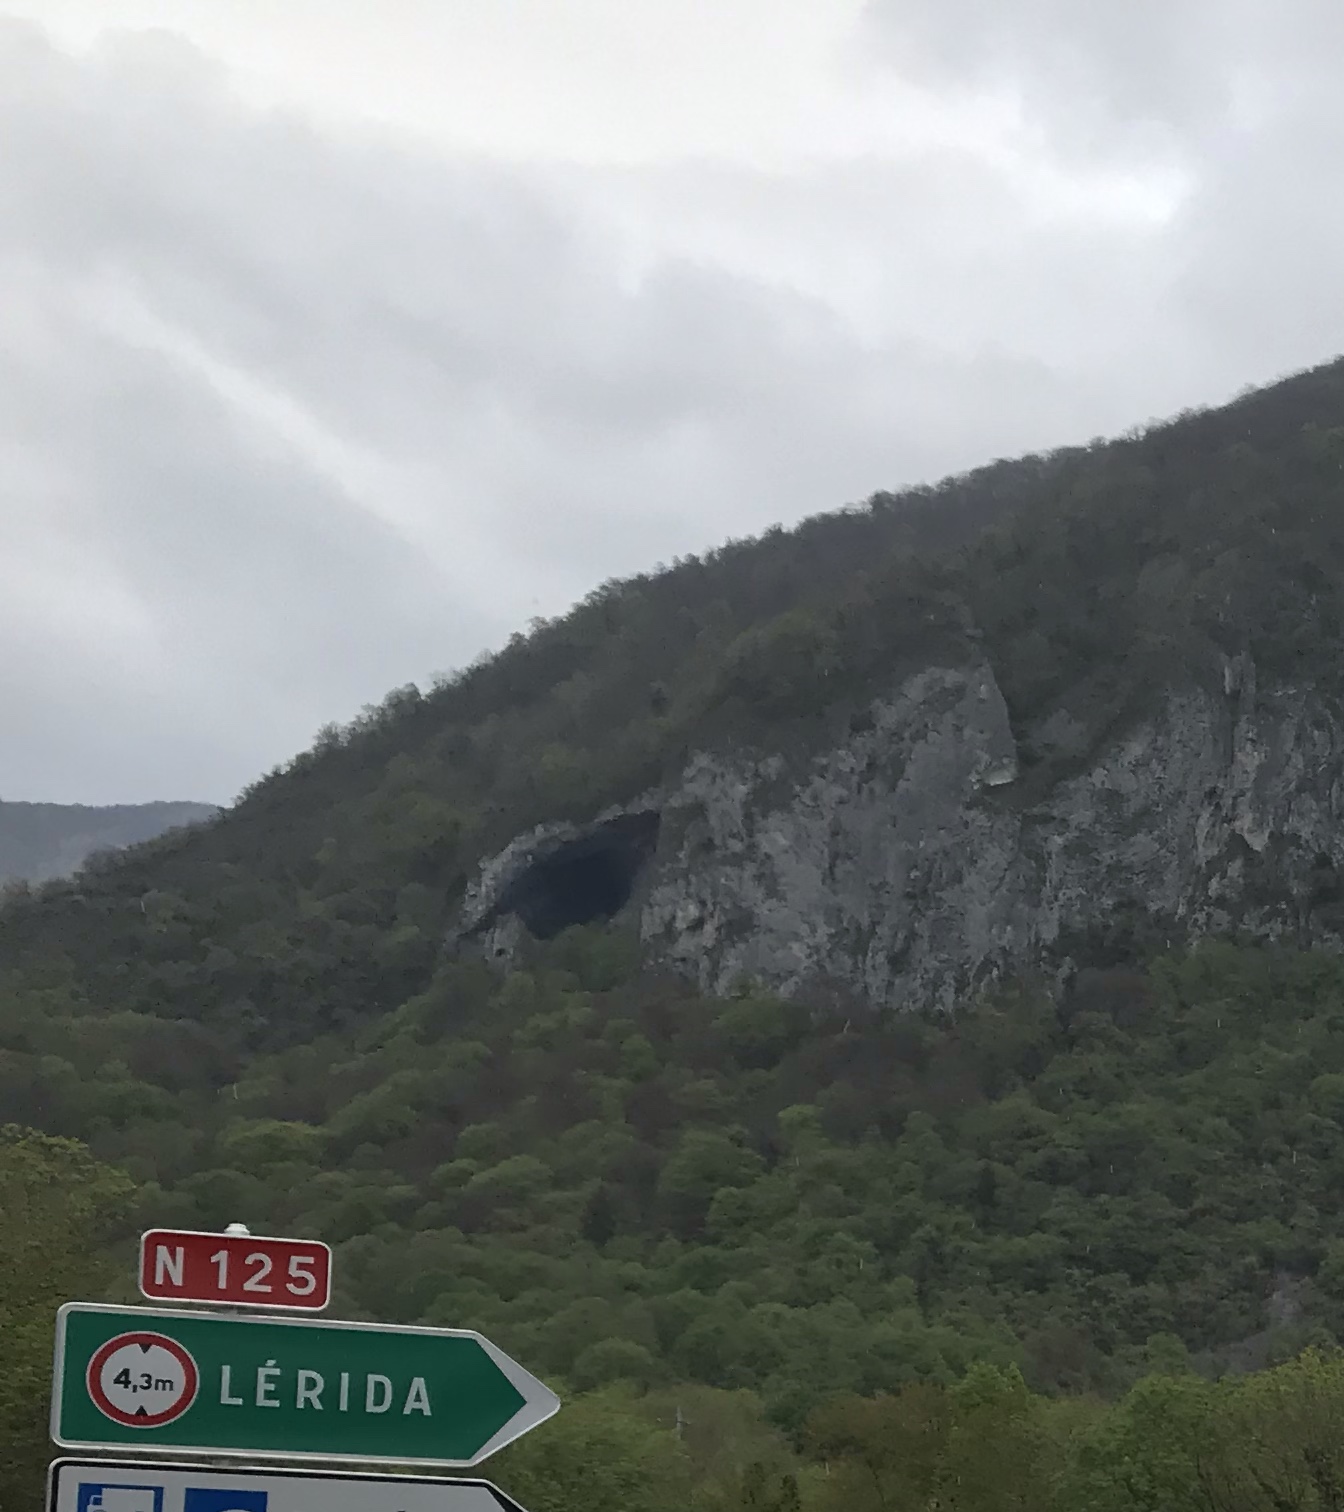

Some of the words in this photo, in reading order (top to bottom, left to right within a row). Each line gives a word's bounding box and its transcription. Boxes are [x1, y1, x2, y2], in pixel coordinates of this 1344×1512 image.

[154, 1244, 185, 1287] N
[210, 1250, 317, 1296] 125
[113, 1367, 175, 1394] 4,3m
[219, 1359, 433, 1417] LÉRIDA
